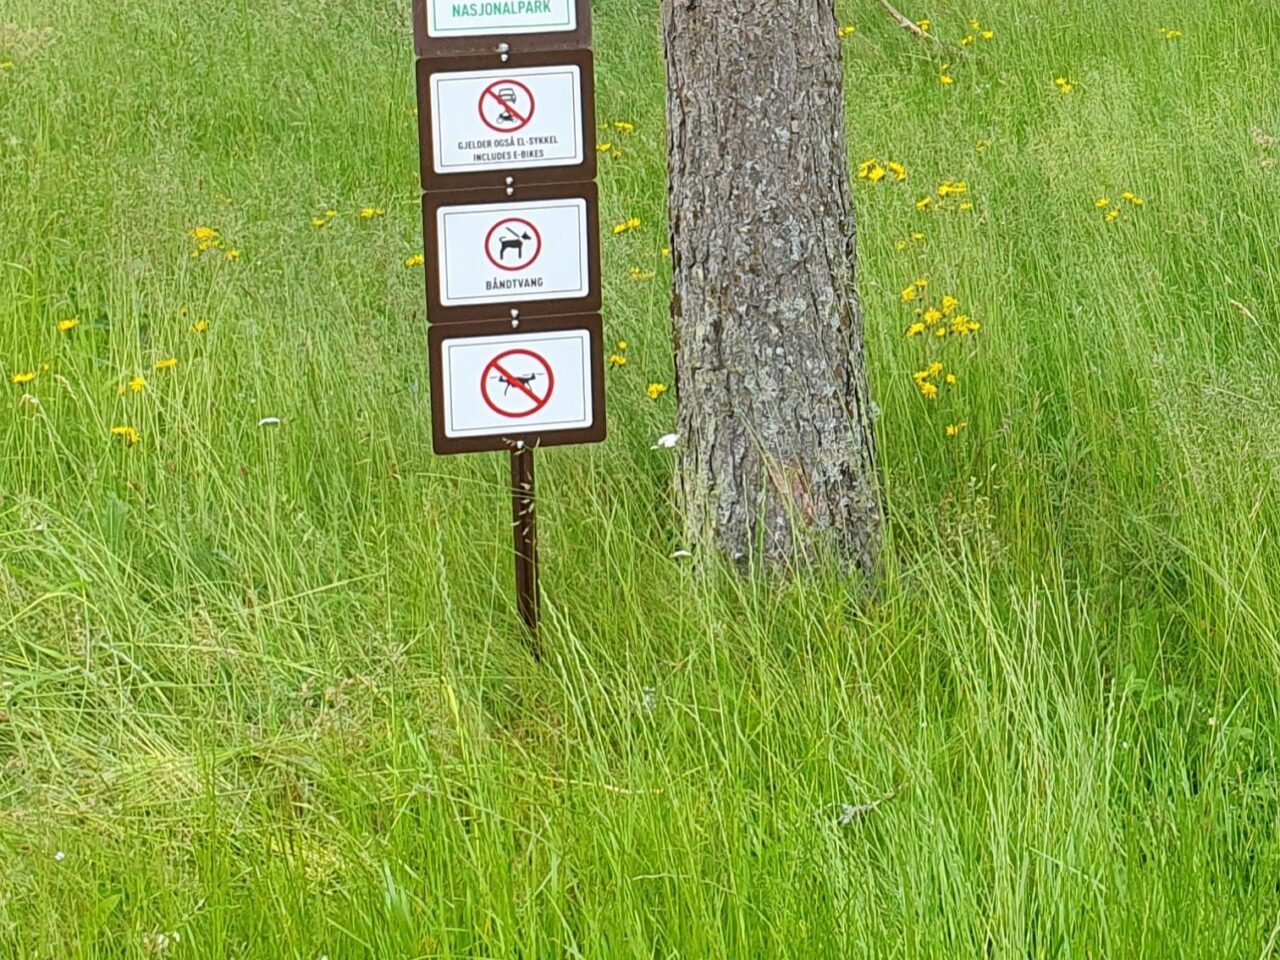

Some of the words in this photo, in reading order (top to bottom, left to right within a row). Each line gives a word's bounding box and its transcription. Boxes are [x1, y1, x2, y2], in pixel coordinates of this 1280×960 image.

[452, 0, 551, 17] NASJONALPARK
[458, 139, 492, 150] GJELDER
[494, 135, 515, 148] OGSÅ
[517, 135, 558, 147] EL-SYKKEL
[473, 151, 511, 162] INCLUDES
[513, 149, 544, 160] E-BIKES
[486, 277, 543, 290] BÅNDTVANG
